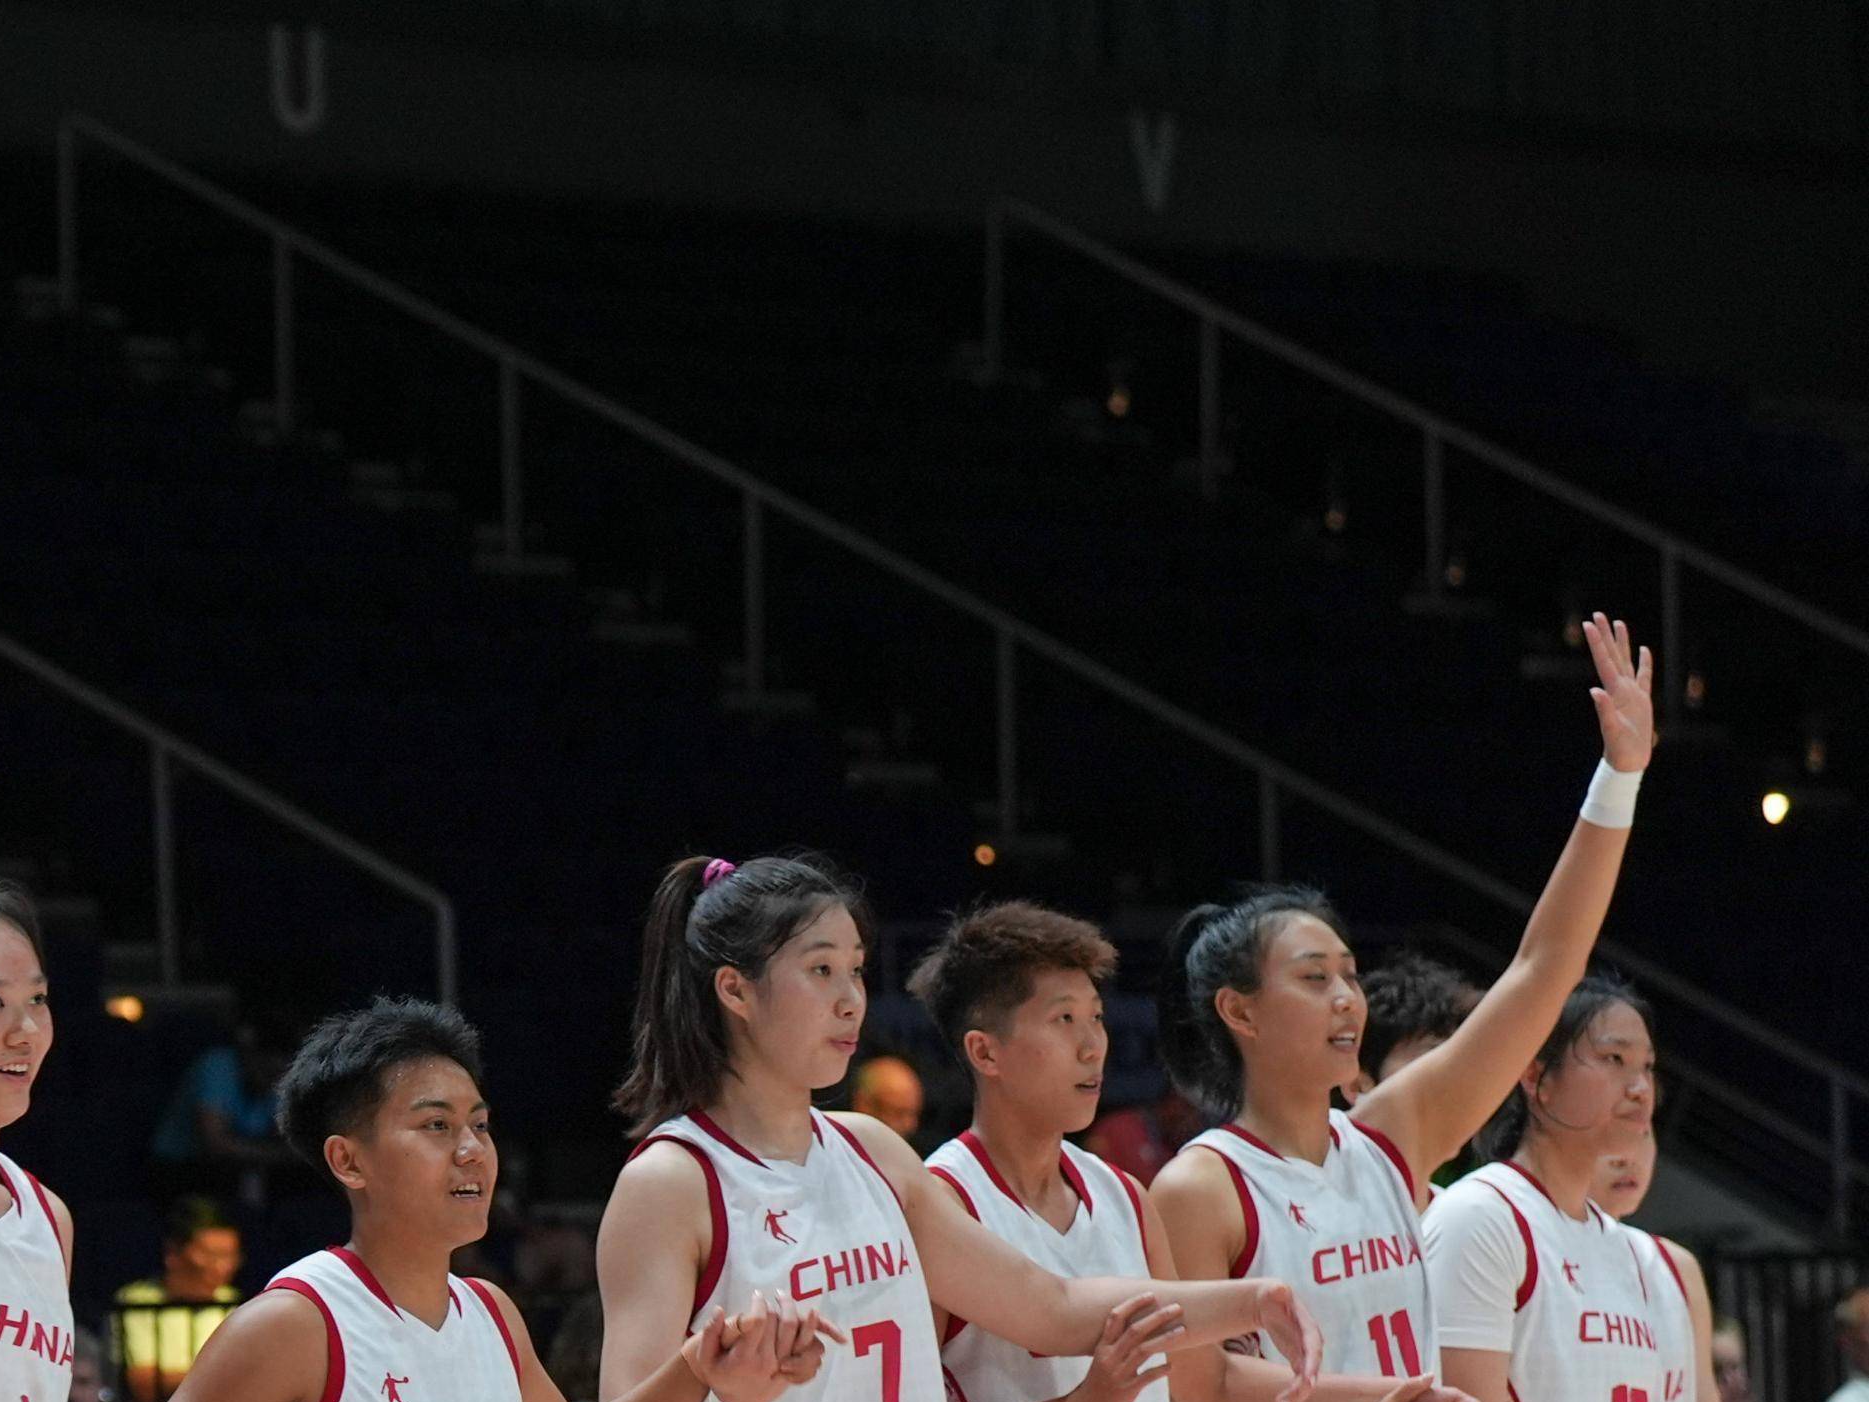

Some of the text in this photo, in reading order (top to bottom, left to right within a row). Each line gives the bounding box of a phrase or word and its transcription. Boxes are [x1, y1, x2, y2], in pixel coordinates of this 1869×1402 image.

[267, 22, 326, 136] U
[790, 1239, 912, 1302] CHINA
[1367, 1308, 1422, 1378] 11
[1579, 1311, 1656, 1351] CHIN
